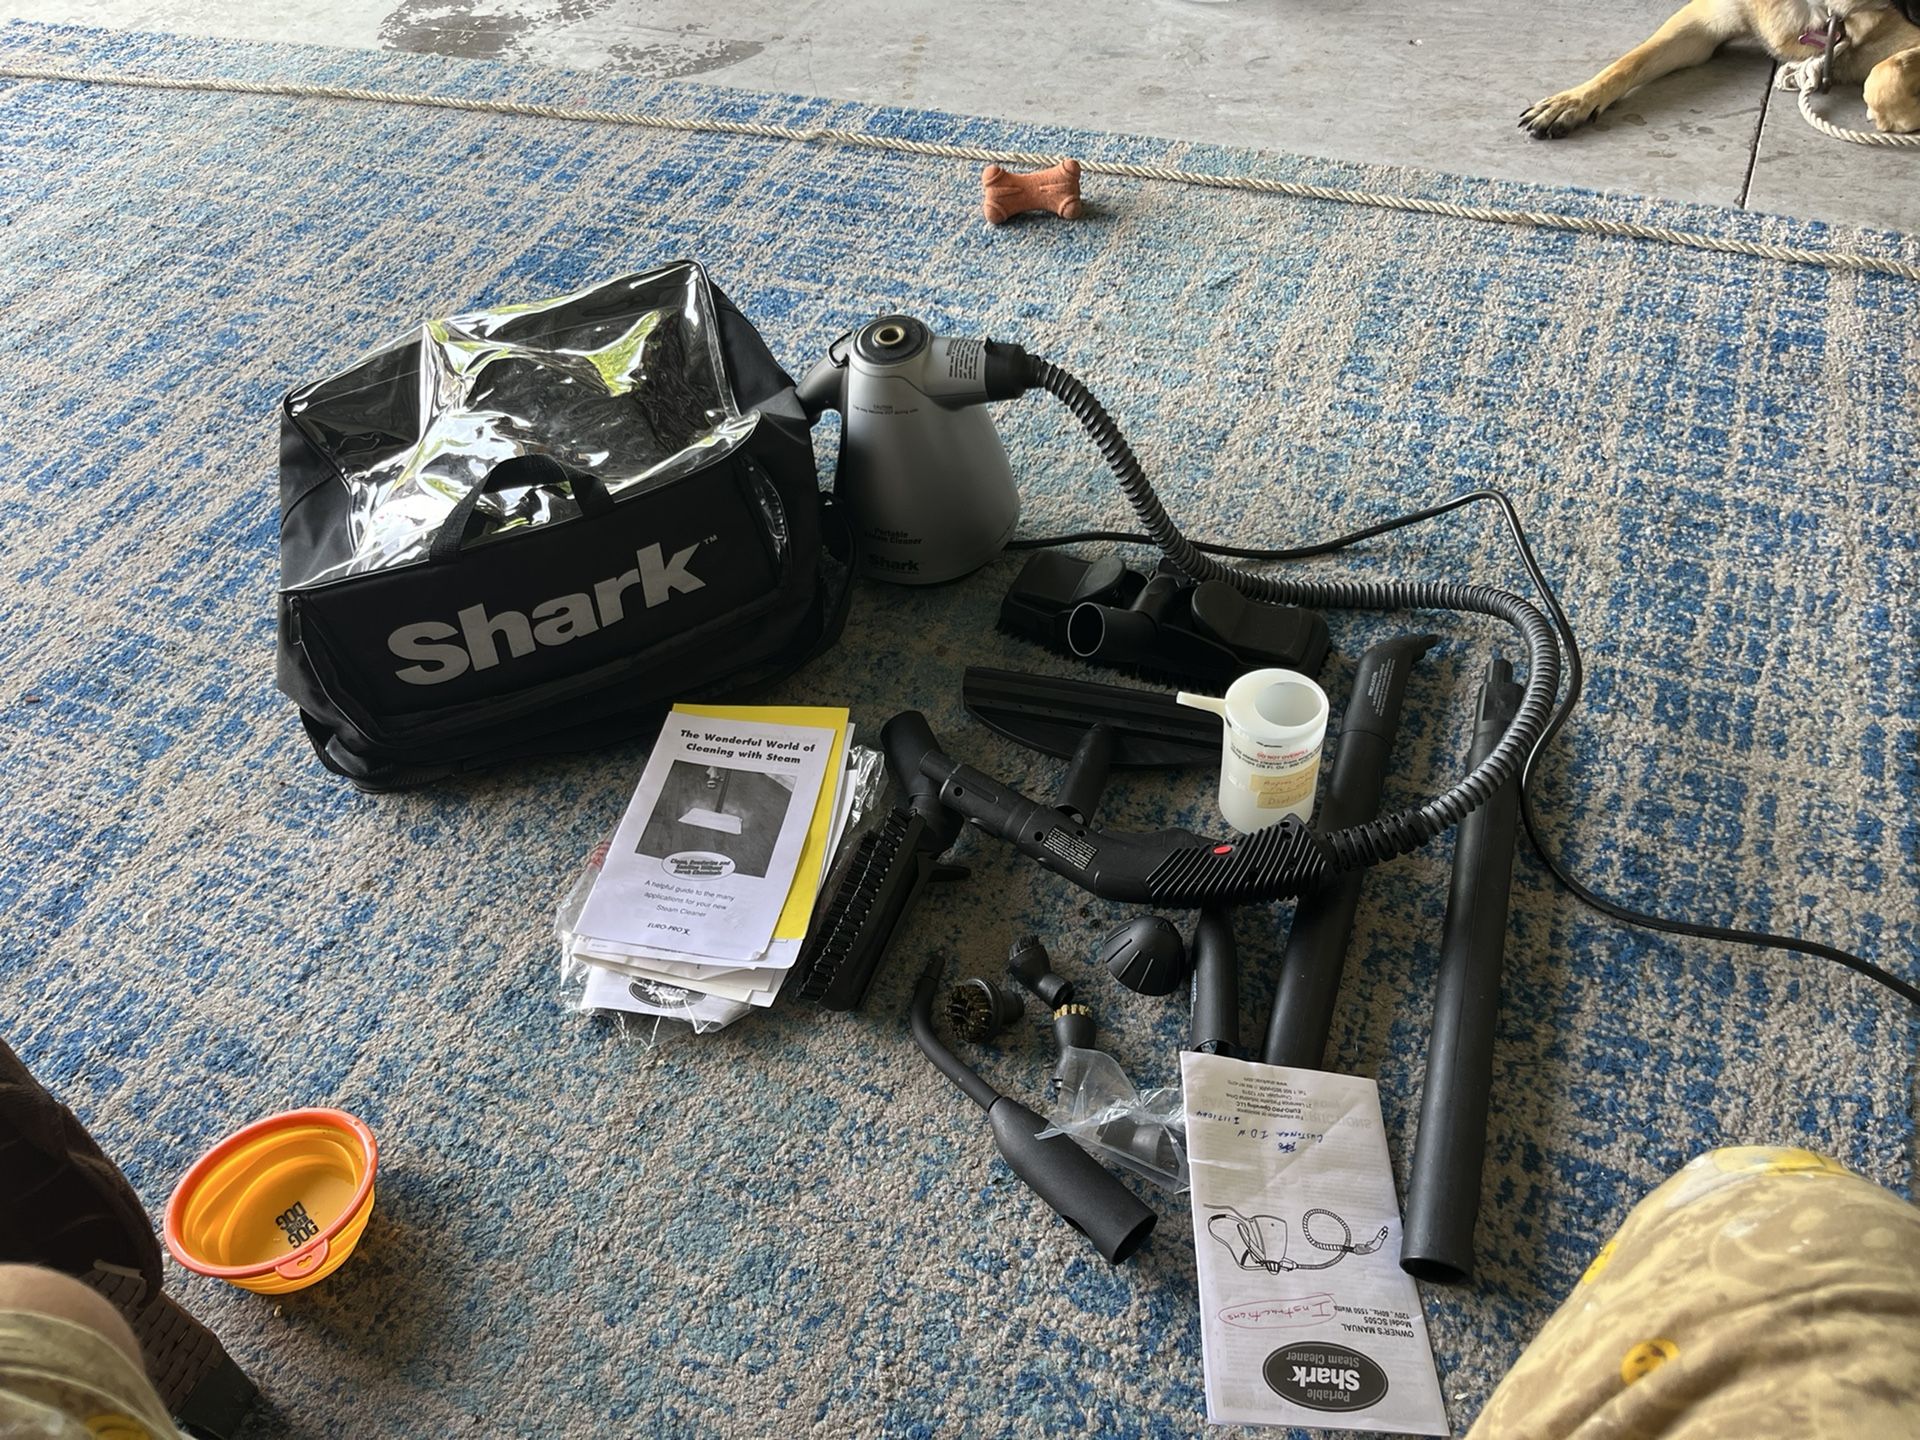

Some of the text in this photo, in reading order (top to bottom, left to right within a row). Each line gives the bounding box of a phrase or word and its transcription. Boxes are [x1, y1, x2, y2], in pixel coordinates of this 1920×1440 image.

[890, 536, 922, 545] Cleaner
[869, 555, 919, 571] Shark
[388, 542, 706, 684] Shark
[680, 729, 816, 752] The Wonderful World of
[686, 743, 800, 764] Cleaning with Steam
[652, 881, 674, 890] helpful
[675, 886, 694, 894] guide
[656, 904, 706, 917] Steam Cleaner
[276, 1201, 307, 1230] DOG
[1227, 1301, 1331, 1321] Instructions
[1363, 1316, 1412, 1328] Model SC505
[1341, 1323, 1414, 1337] OWNER'S MANUAL
[1286, 1352, 1360, 1367] Steam Cleaner
[1292, 1366, 1360, 1391] Shark
[1306, 1388, 1350, 1402] Portable
